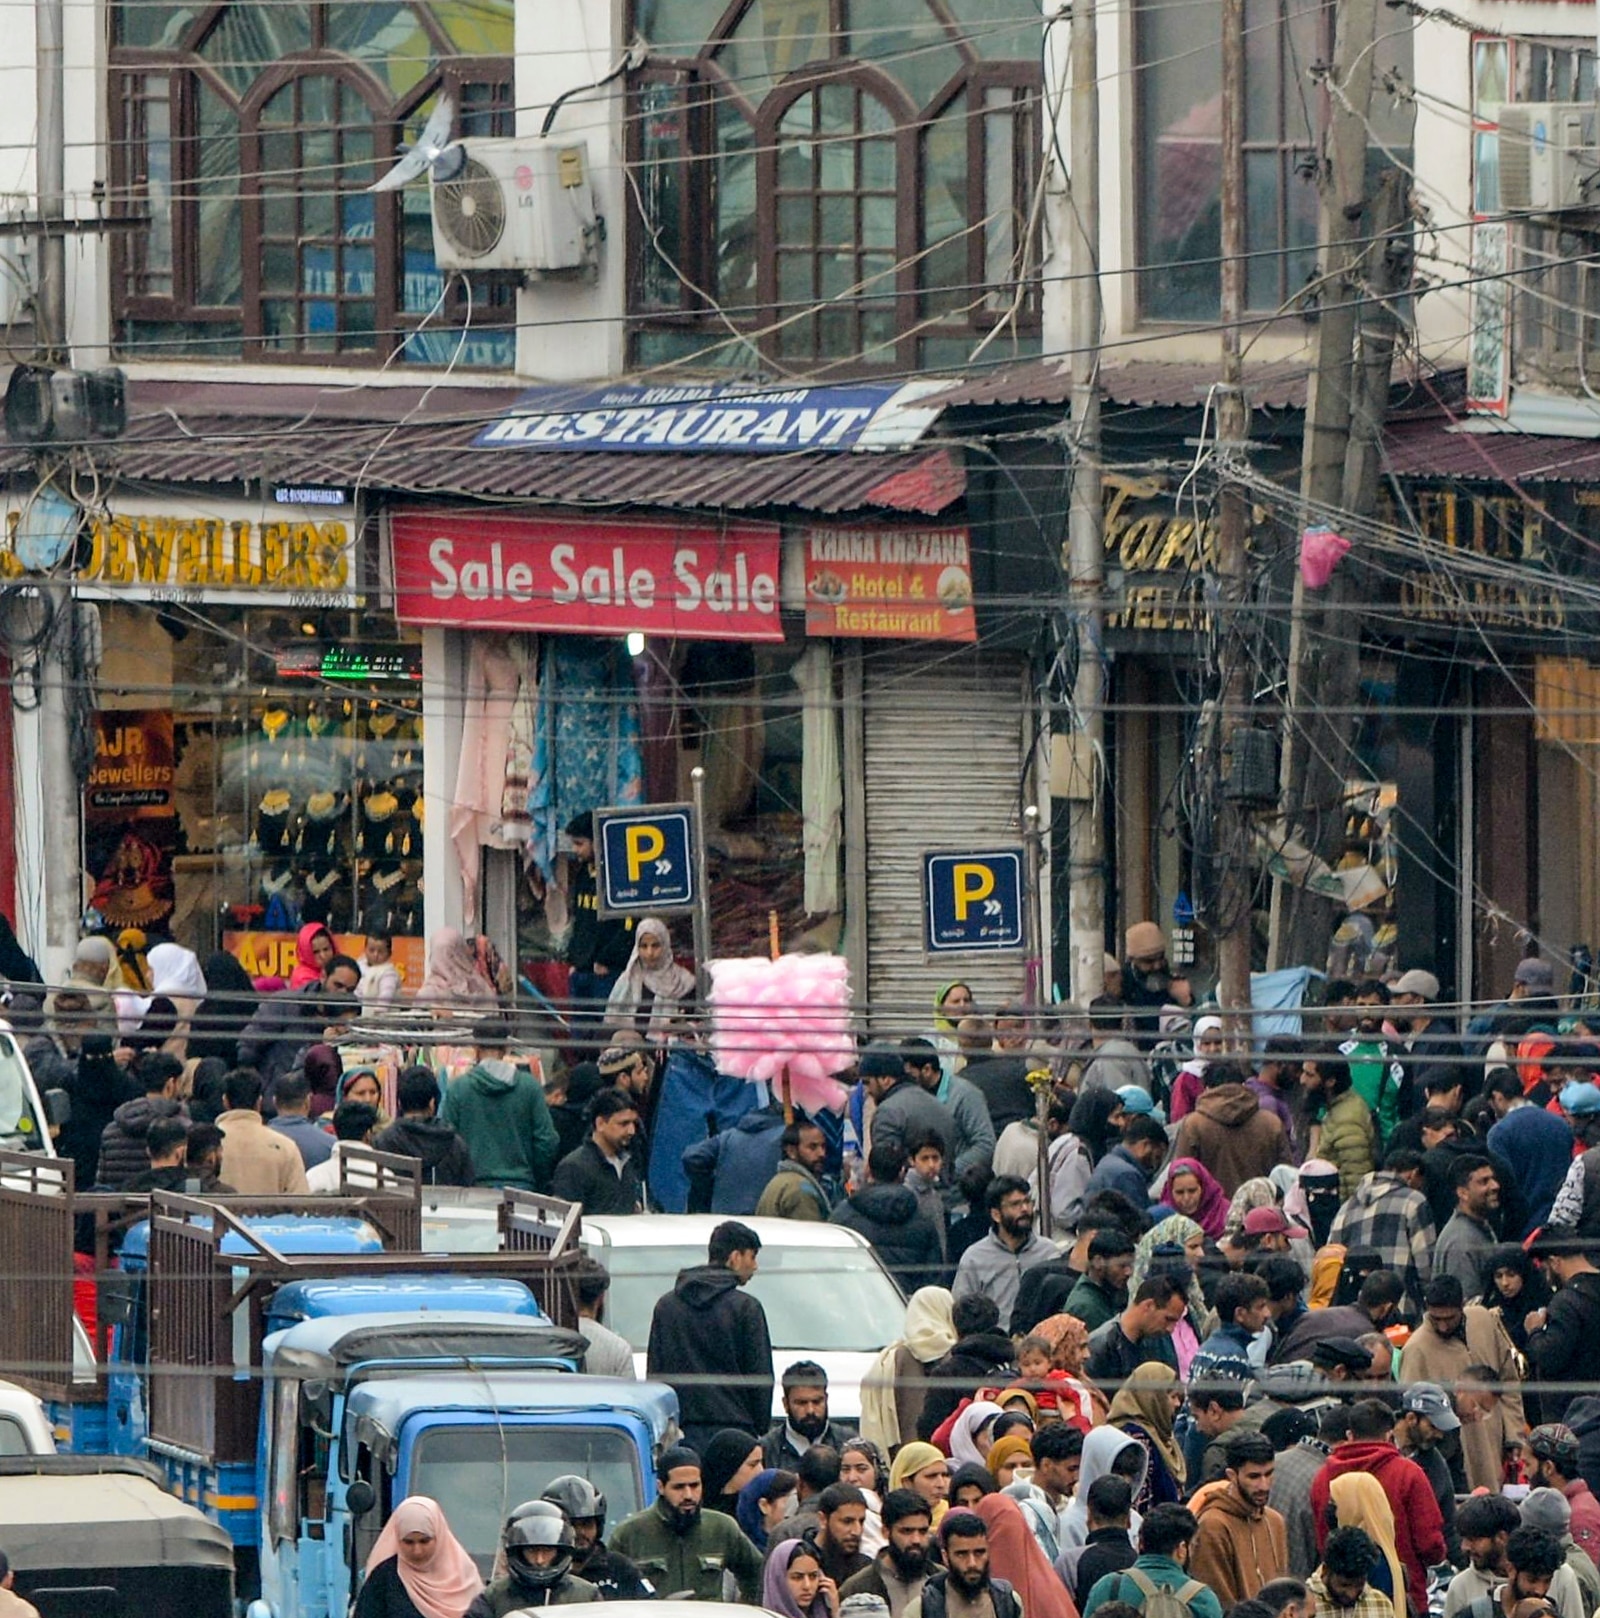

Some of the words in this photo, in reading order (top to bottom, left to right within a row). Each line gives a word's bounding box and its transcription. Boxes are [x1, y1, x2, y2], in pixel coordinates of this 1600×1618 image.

[638, 386, 709, 405] KHANA
[484, 405, 872, 447] RESTAURANT
[80, 513, 350, 588] JEWELLERS
[810, 529, 877, 563] KHANA
[880, 531, 968, 566] KHAZANA
[430, 538, 533, 603] Sale
[551, 543, 655, 609] Sale
[674, 550, 775, 615] Sale
[851, 572, 903, 599] Hotel
[908, 576, 924, 598] &
[835, 605, 941, 633] Restaurant
[89, 764, 171, 785] Jewellers
[624, 824, 665, 882] P
[953, 863, 994, 921] P
